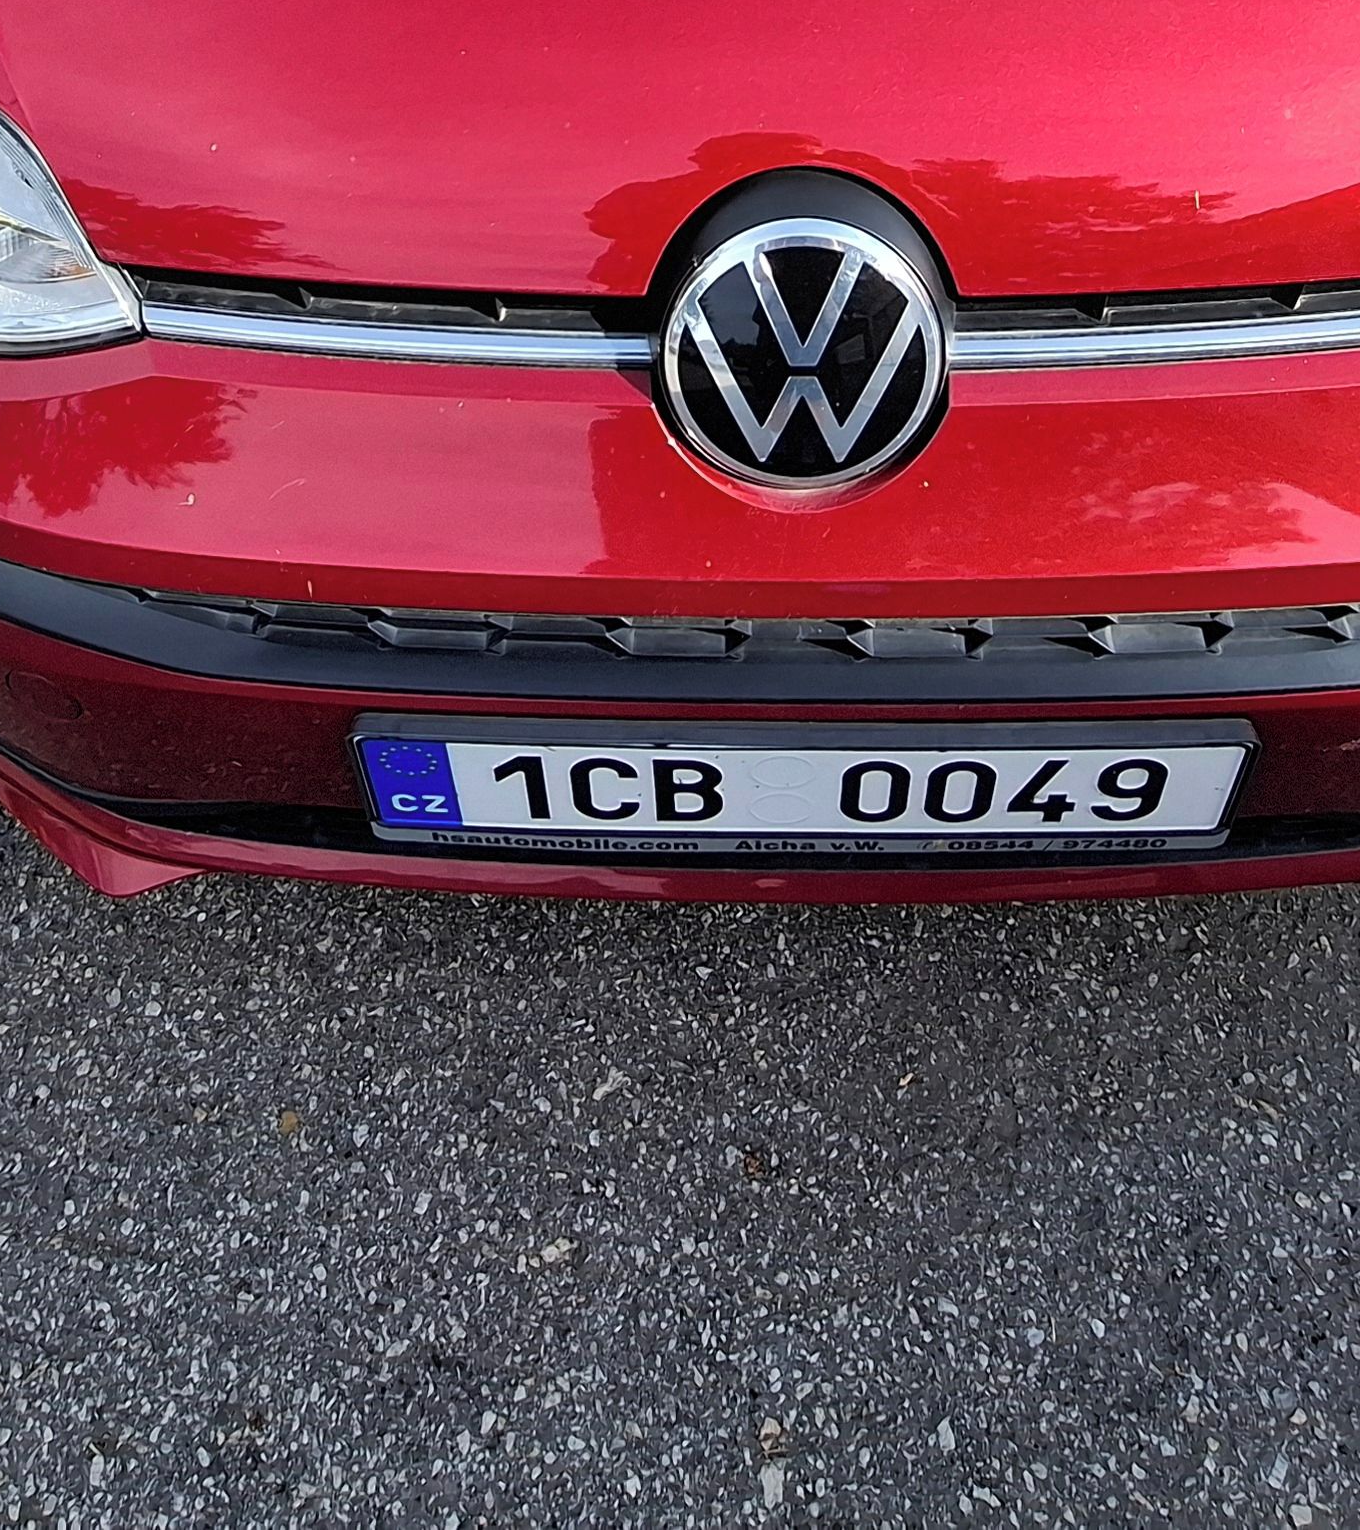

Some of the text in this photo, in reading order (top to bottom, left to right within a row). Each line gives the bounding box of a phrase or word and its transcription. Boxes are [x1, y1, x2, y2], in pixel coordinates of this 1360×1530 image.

[680, 238, 928, 466] VW
[390, 793, 449, 814] CZ
[492, 755, 1170, 823] 1CB 0049
[431, 831, 700, 852] hsautomobile.com
[947, 839, 1035, 852] 08544
[1061, 837, 1168, 851] 974480
